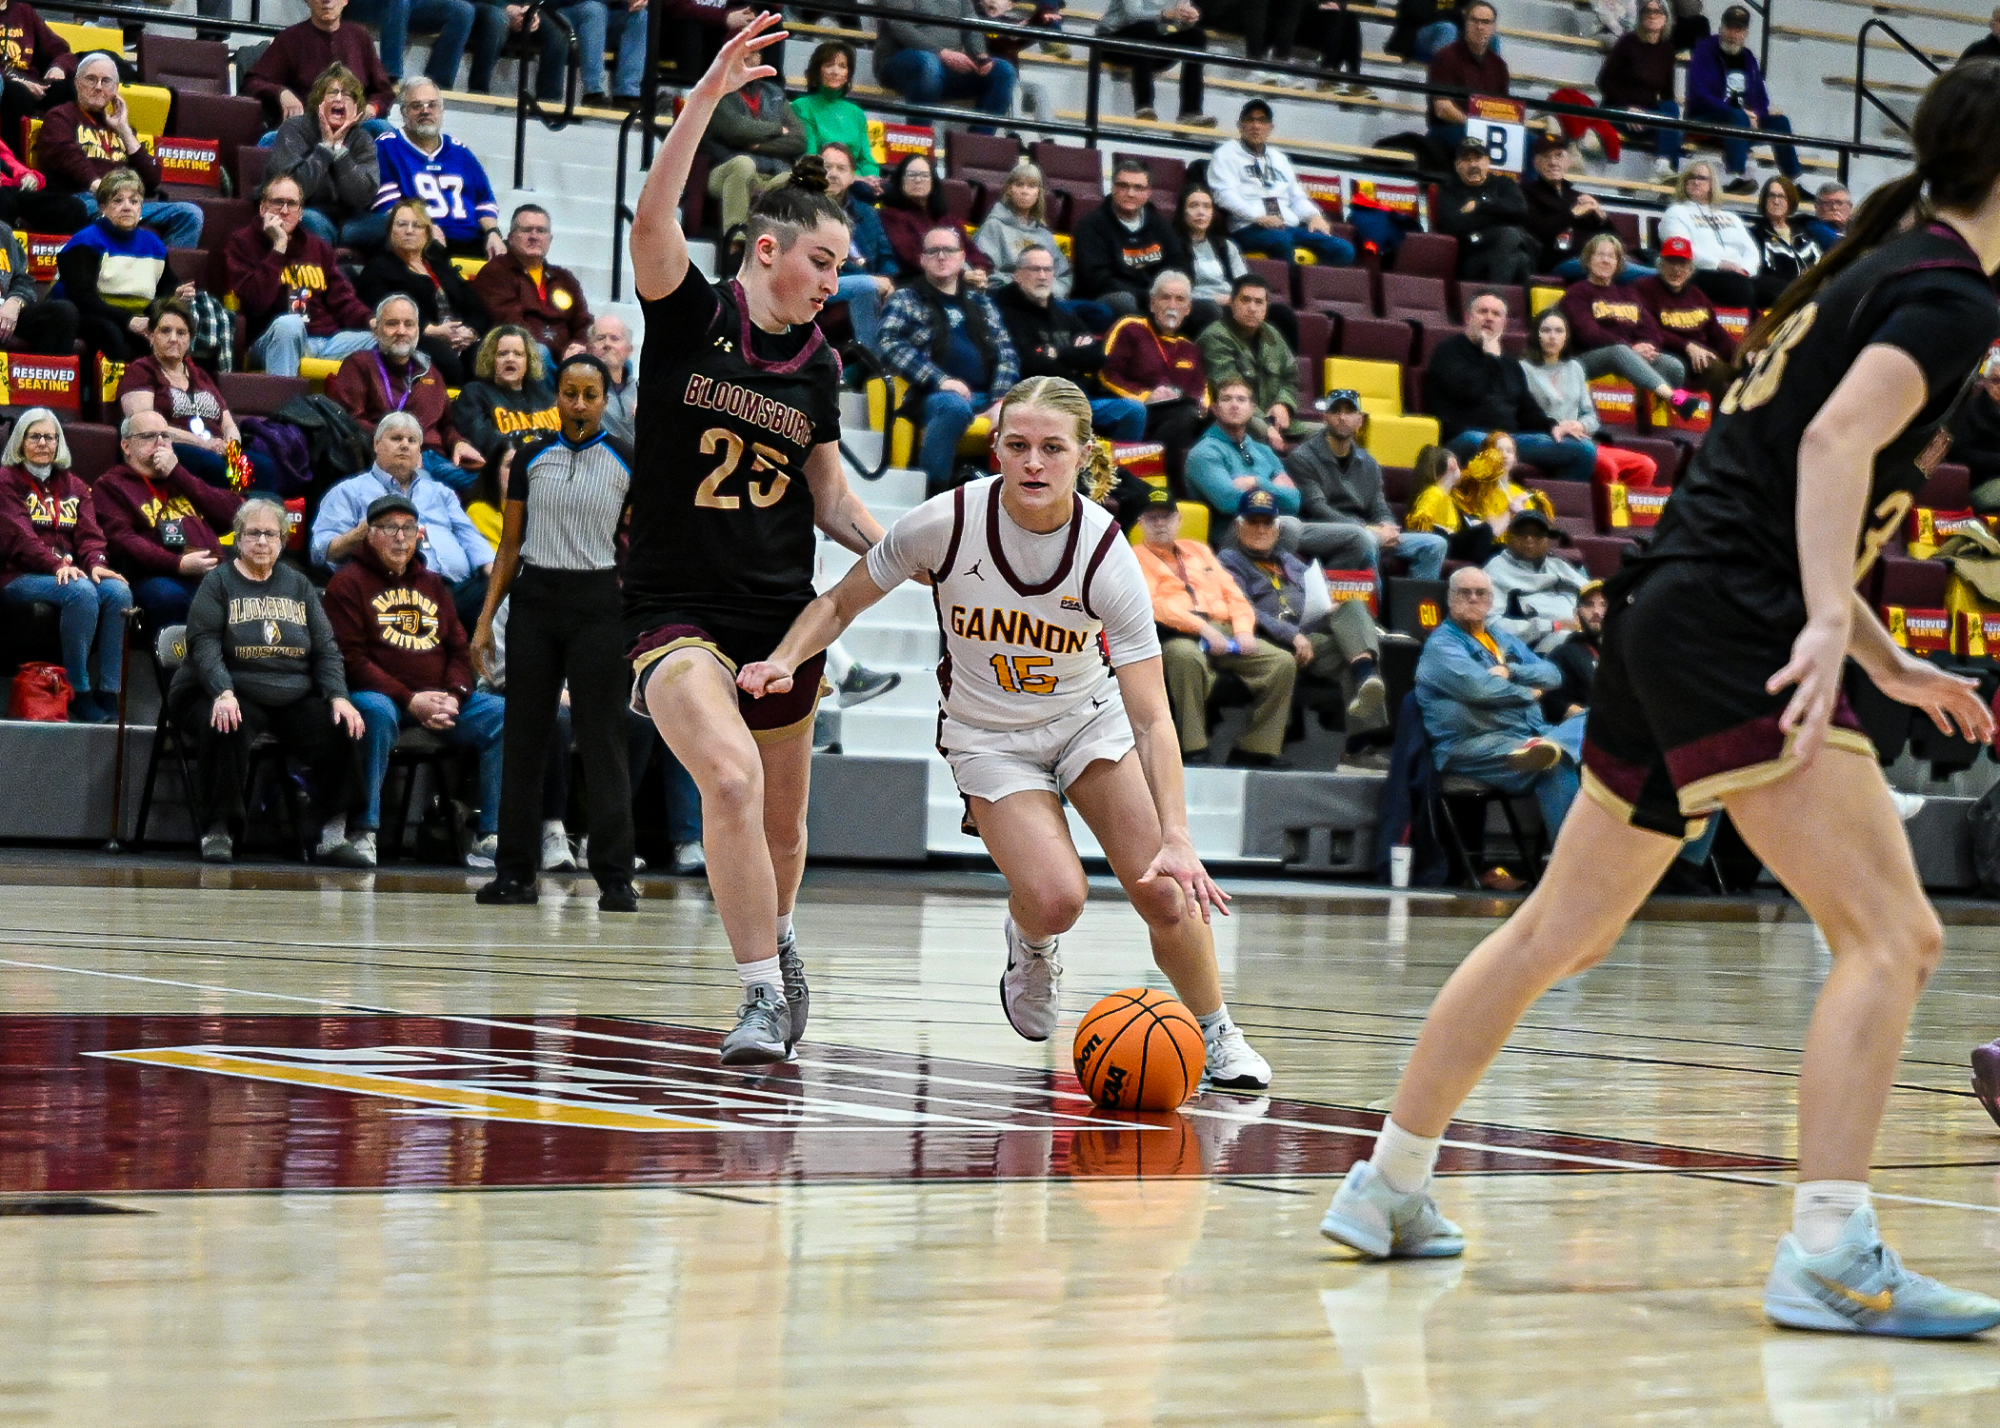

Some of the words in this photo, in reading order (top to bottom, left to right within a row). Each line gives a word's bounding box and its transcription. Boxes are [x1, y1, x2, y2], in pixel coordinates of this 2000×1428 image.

[158, 147, 216, 162] RESERVED
[1486, 125, 1507, 166] B
[163, 157, 210, 171] SEATING
[414, 172, 467, 218] 97
[13, 367, 75, 382] RESERVED
[18, 378, 69, 392] SEATING
[1592, 392, 1633, 403] RESERVED
[694, 427, 791, 509] 25
[1420, 604, 1438, 626] GU
[1906, 618, 1947, 629] RESERVED
[951, 605, 1089, 654] GANNON
[990, 653, 1059, 694] 15
